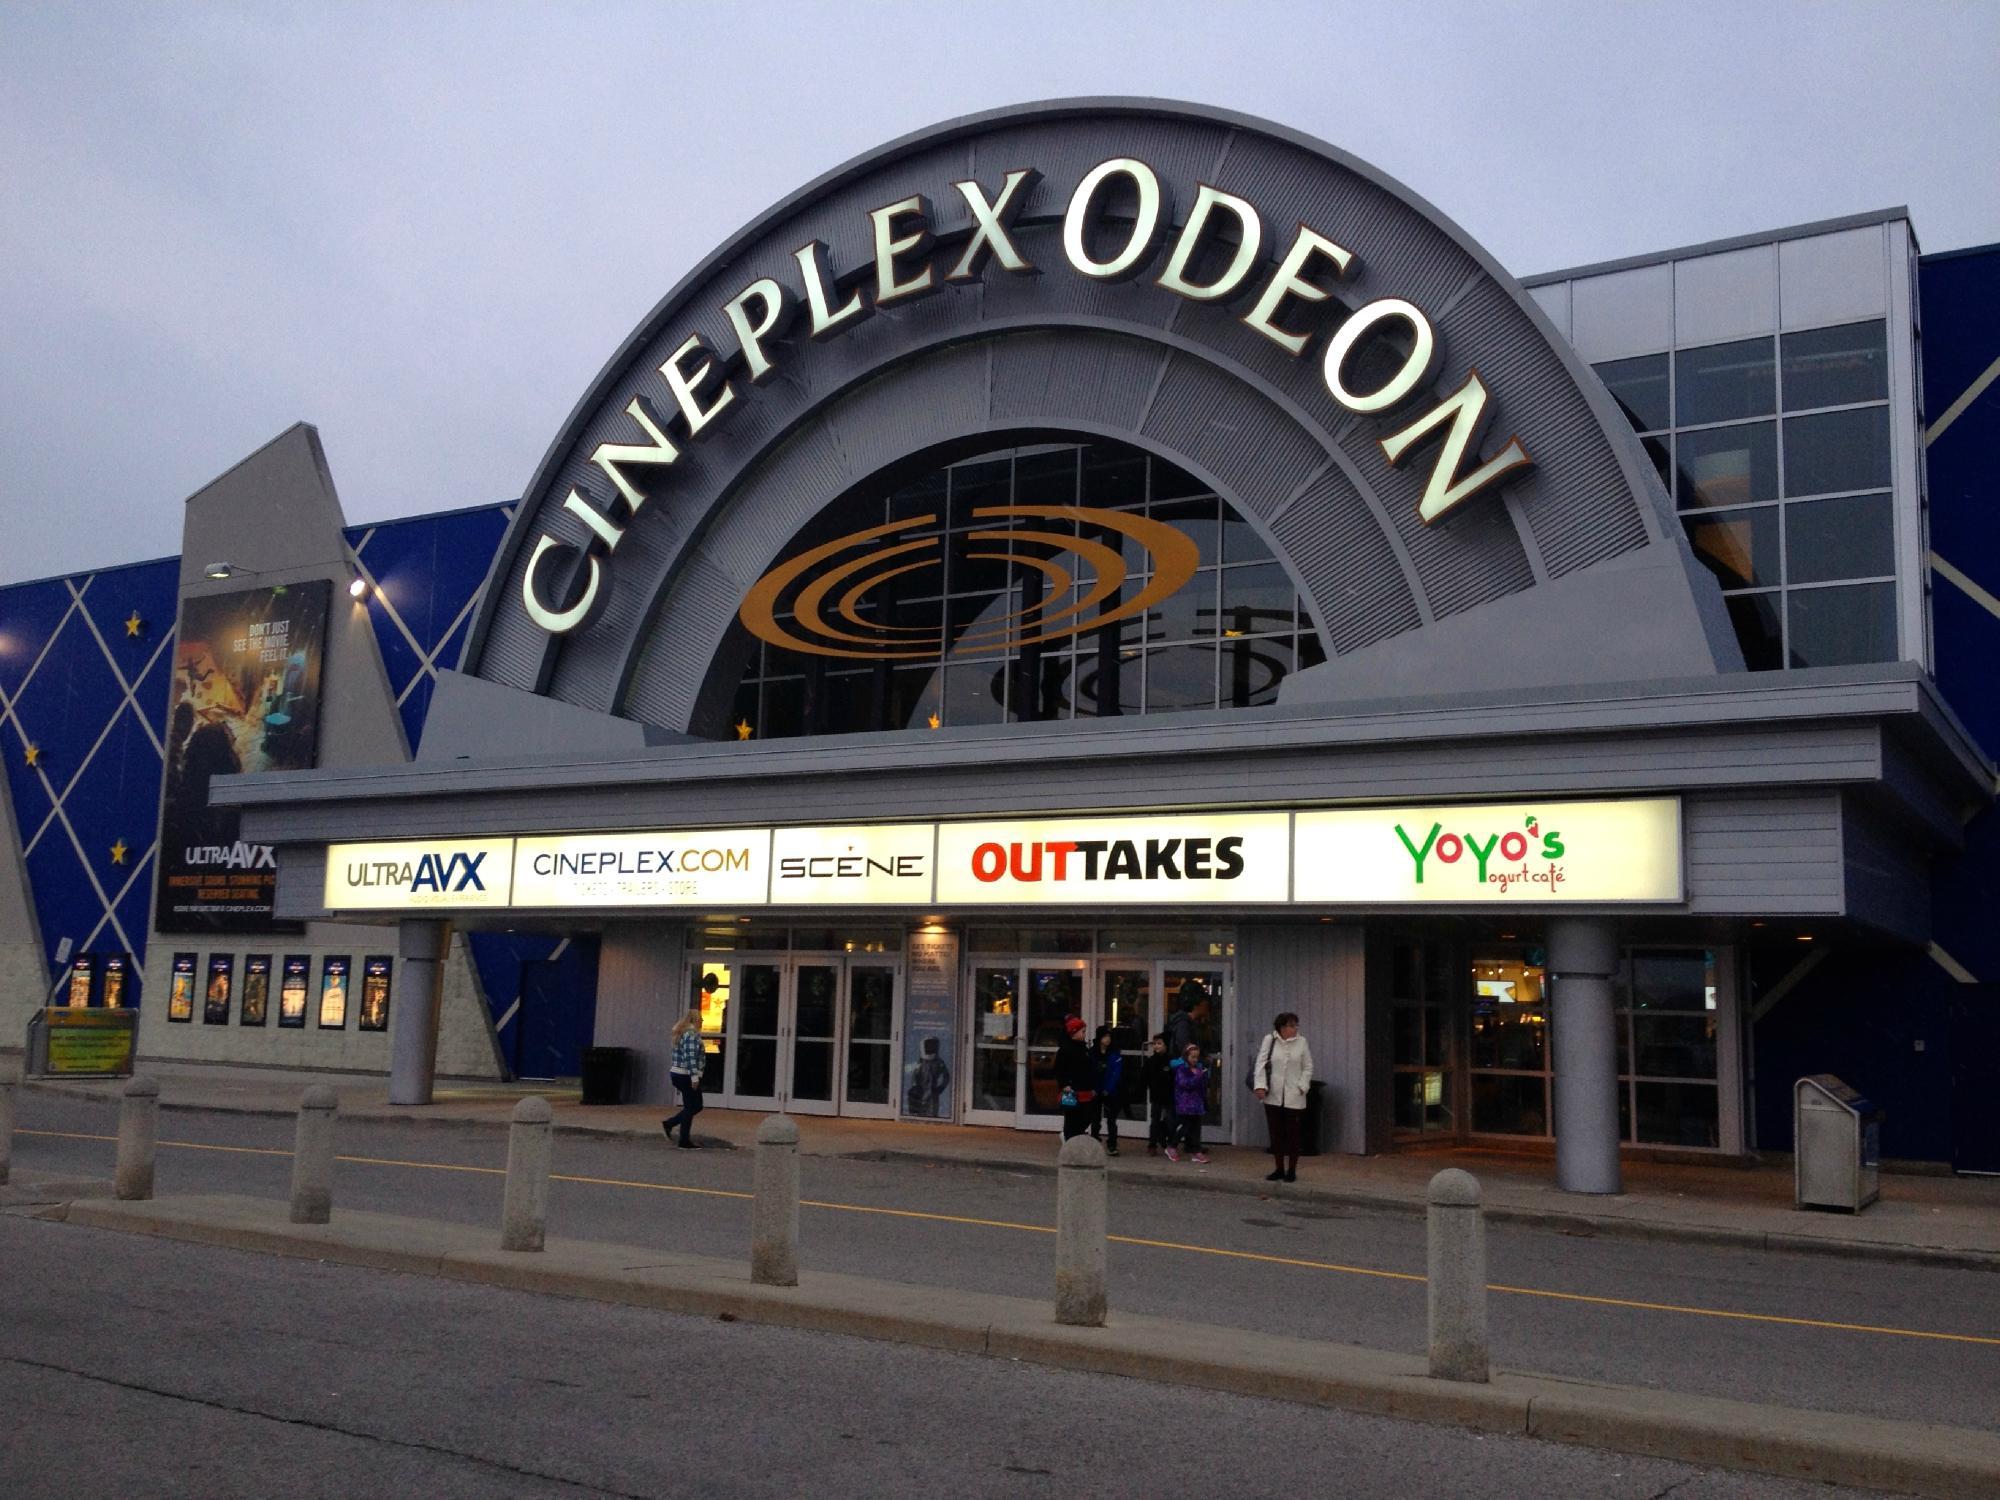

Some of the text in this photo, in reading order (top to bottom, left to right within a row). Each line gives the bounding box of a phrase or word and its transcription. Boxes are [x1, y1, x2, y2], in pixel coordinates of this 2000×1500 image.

[522, 157, 1532, 632] CINEPLEX ODEON
[272, 620, 290, 634] JUST
[249, 636, 263, 649] THE
[533, 849, 750, 876] CINEPLEX.COM
[971, 836, 1245, 883] OUTTAKES
